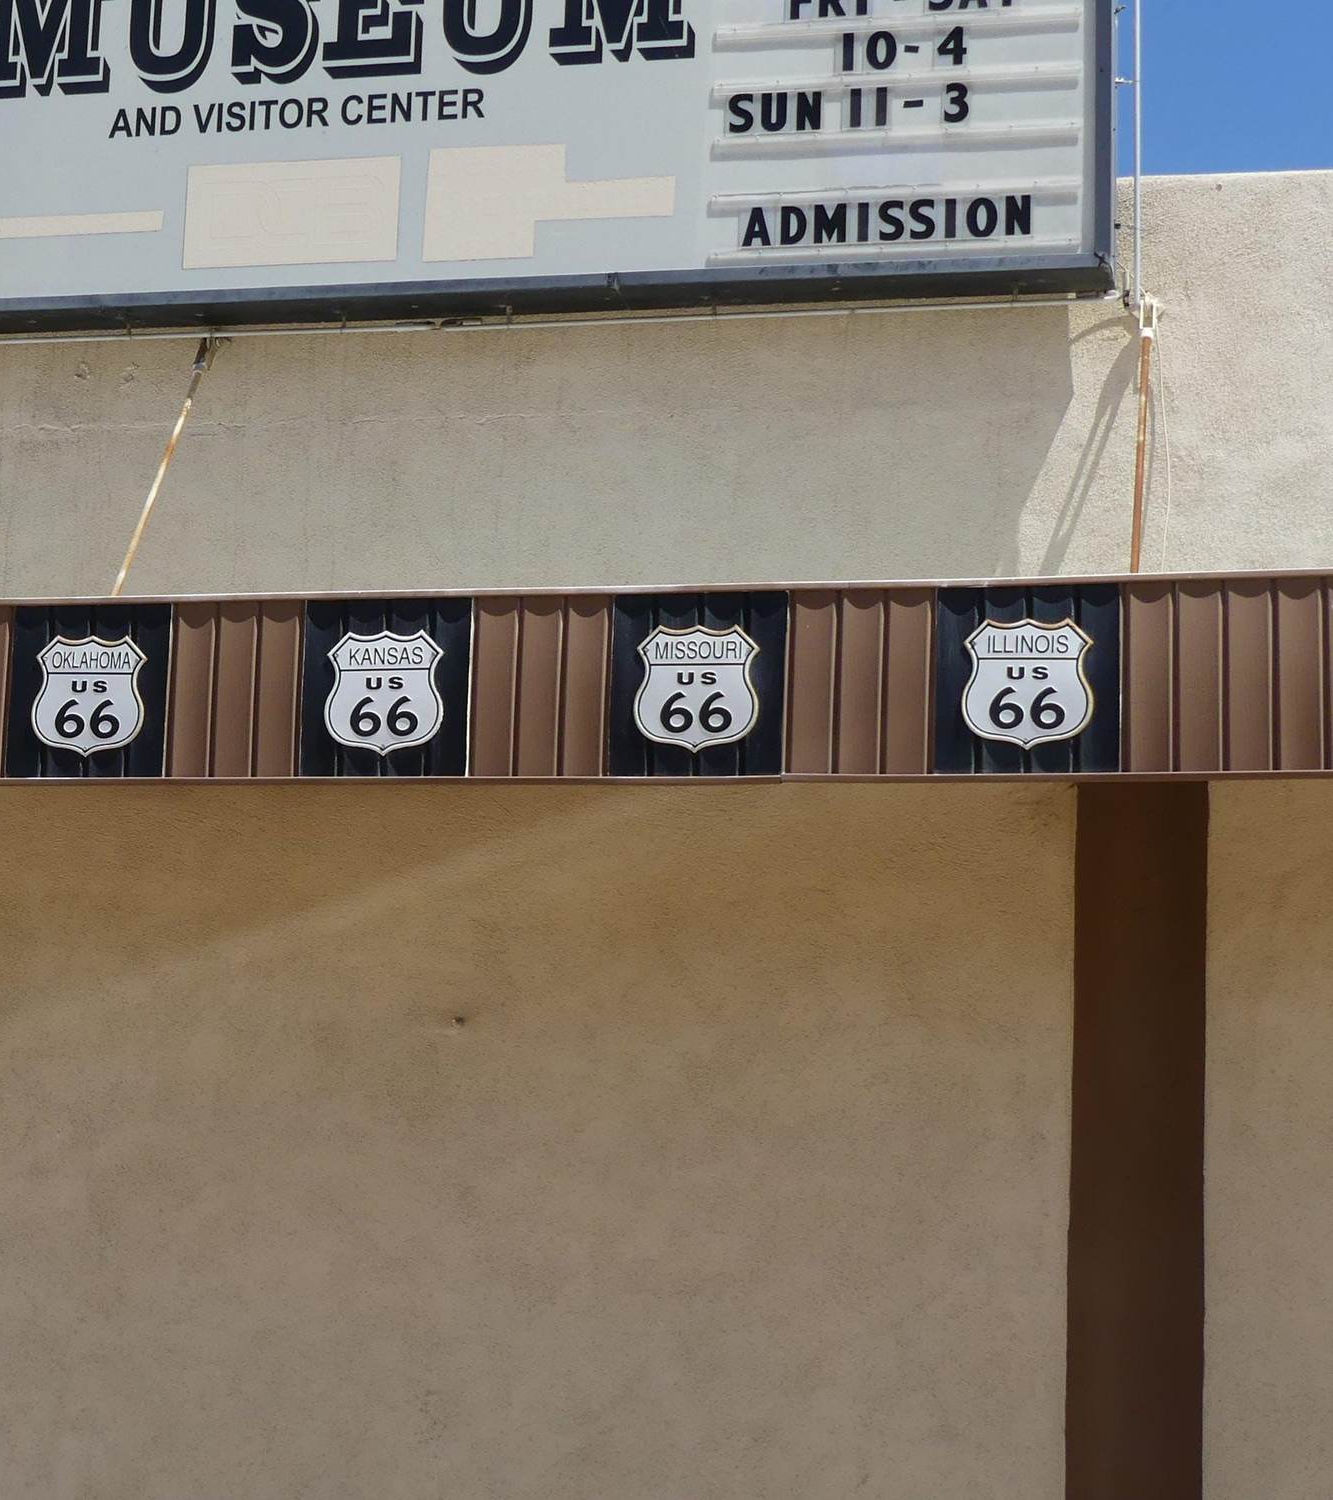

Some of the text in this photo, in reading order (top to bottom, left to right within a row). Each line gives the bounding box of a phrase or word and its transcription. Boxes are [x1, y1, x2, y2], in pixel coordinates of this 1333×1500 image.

[108, 88, 485, 138] AND VISITOR CENTER
[728, 91, 822, 133] SUN
[742, 195, 1032, 247] ADMISSION
[654, 640, 743, 660] MISSOURI
[986, 634, 1070, 654] ILLINOIS
[51, 651, 131, 669] OKLAHOMA
[348, 646, 424, 666] KANSAS
[366, 675, 404, 689] US
[677, 671, 717, 685] US
[1007, 666, 1049, 680] US
[71, 680, 108, 693] US
[349, 695, 419, 737] 66
[660, 691, 733, 734] 66
[989, 686, 1066, 730] 66
[54, 698, 120, 739] 66
